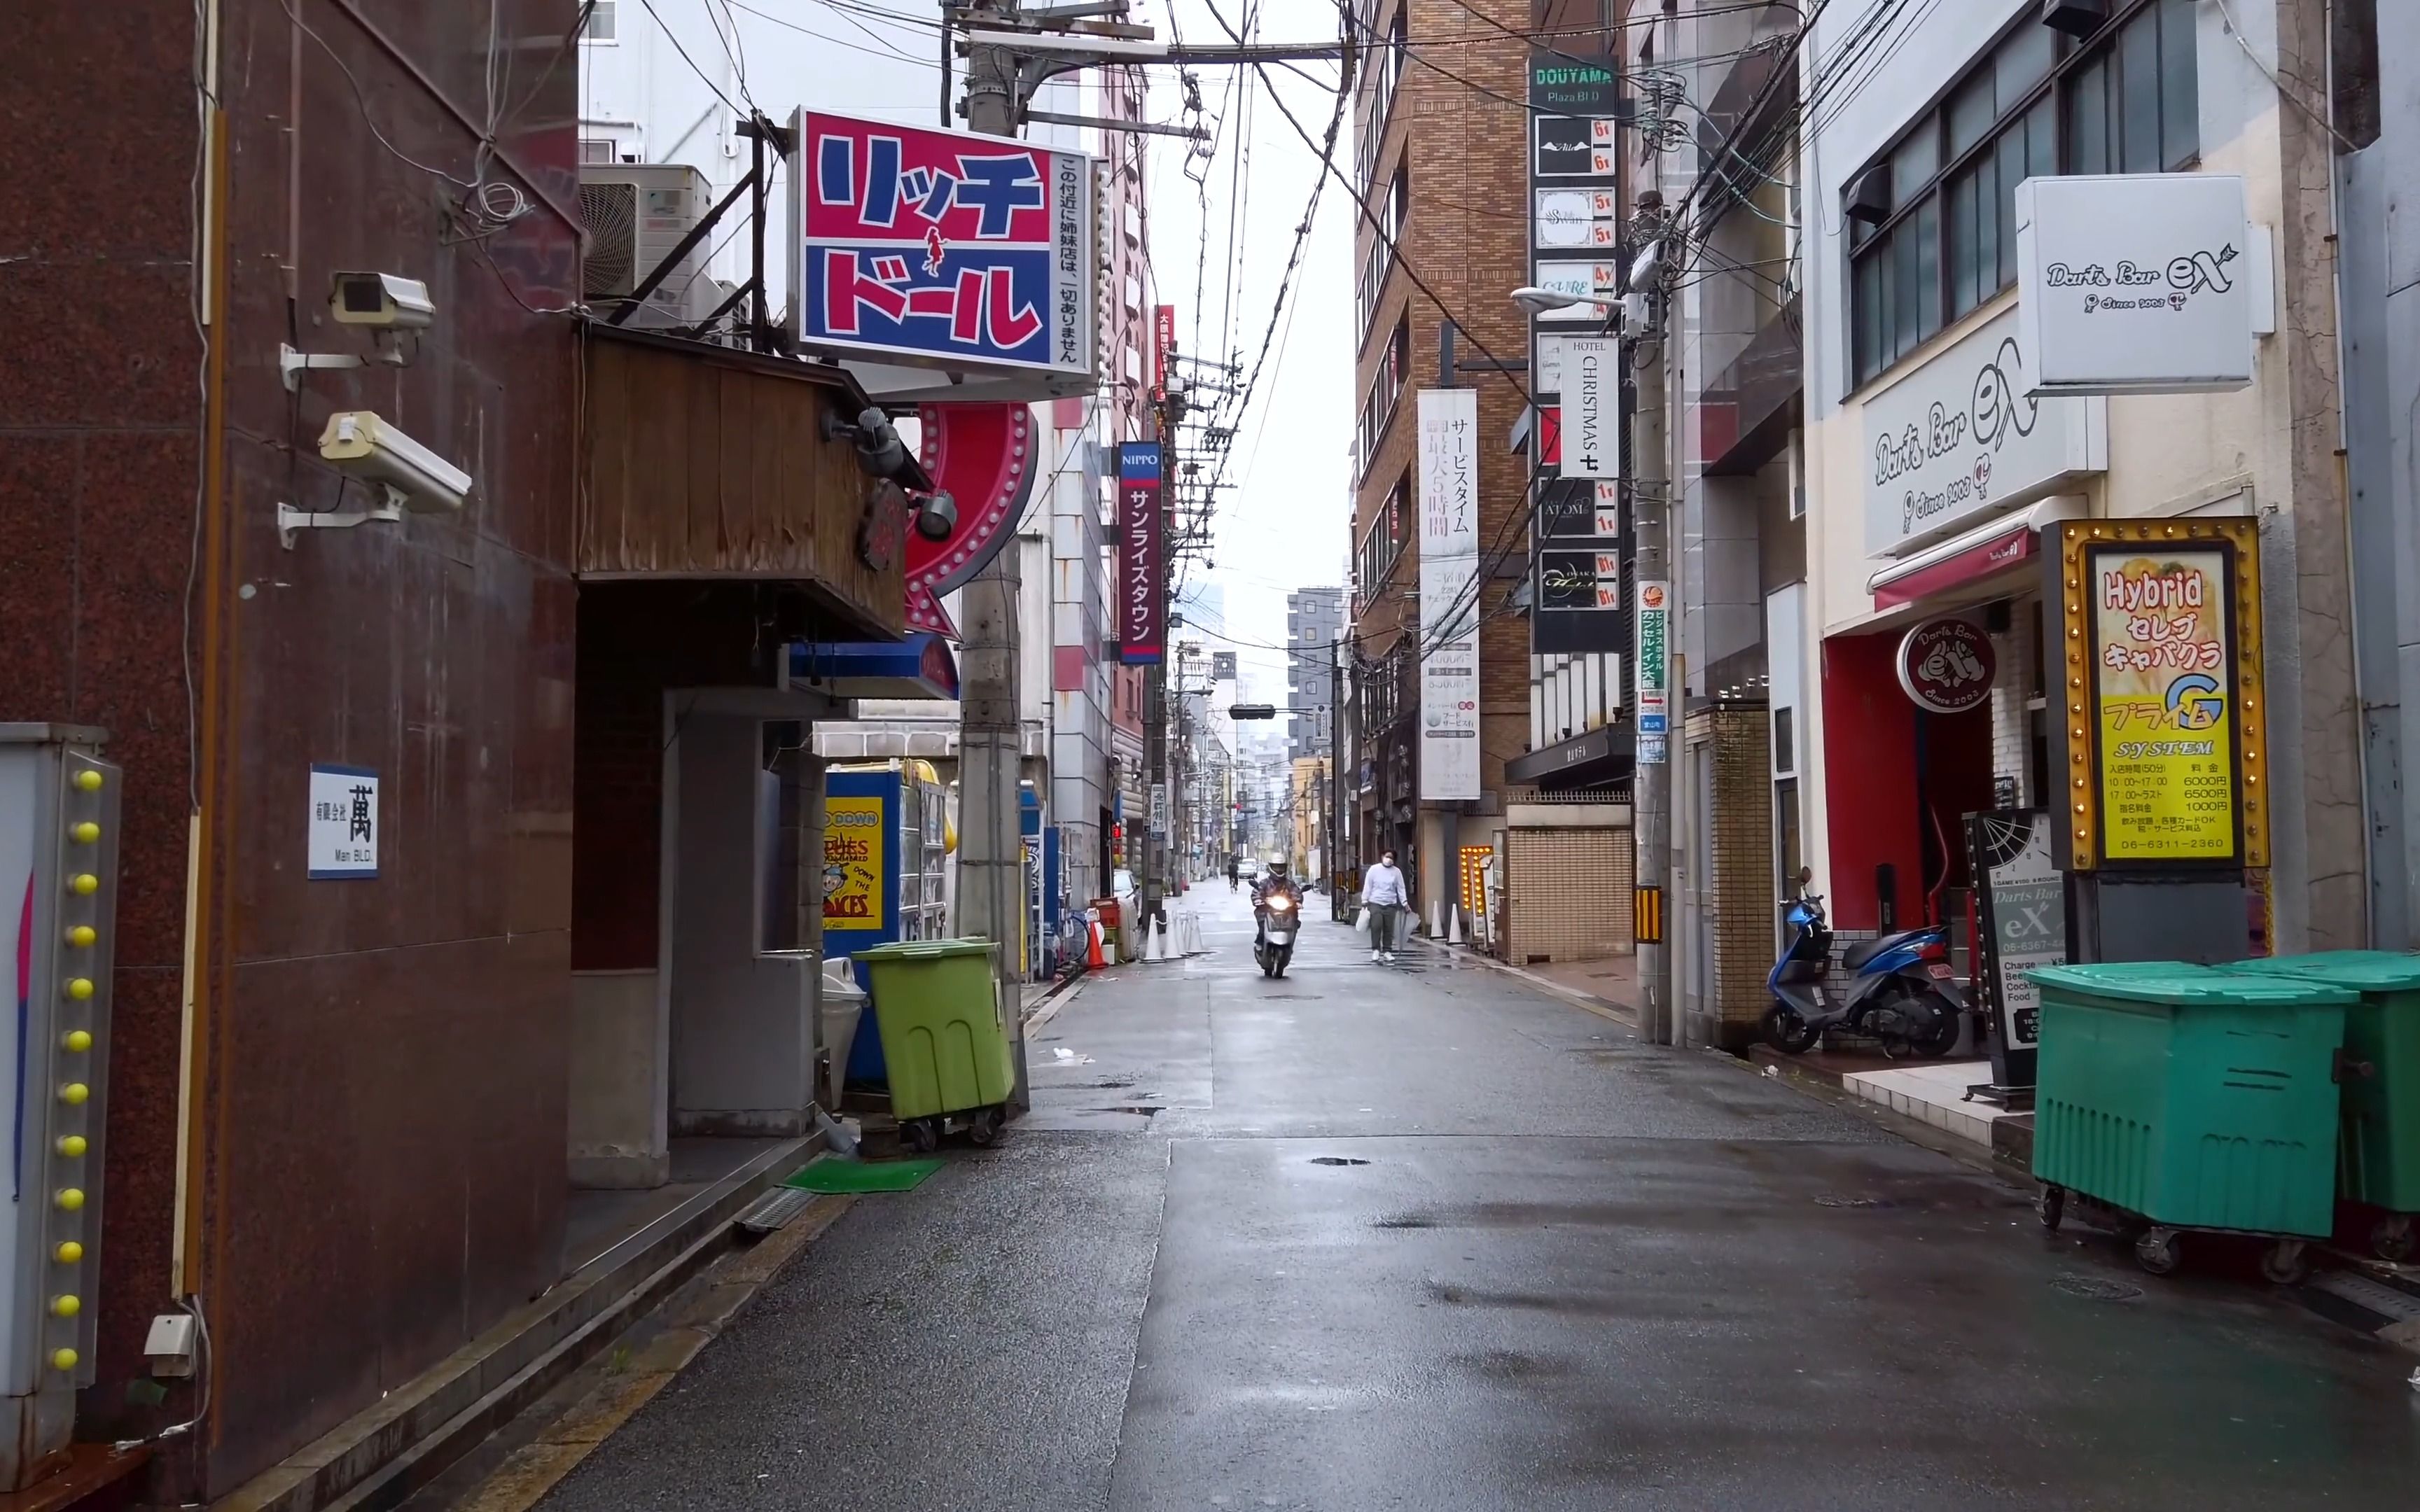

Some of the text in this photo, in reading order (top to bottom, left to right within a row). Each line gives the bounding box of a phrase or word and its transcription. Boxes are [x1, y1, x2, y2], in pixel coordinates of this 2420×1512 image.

[1536, 69, 1612, 85] DOUYAMA
[1548, 92, 1575, 102] Plaza
[817, 134, 1044, 239] リッチ
[1059, 158, 1077, 363] この付近に姉妹店は、一切ありません
[2116, 260, 2161, 285] Bar
[824, 248, 1043, 350] ドール
[2101, 297, 2136, 309] Since
[1573, 342, 1606, 351] HOTEL
[1583, 356, 1597, 450] CHRISTMAS
[1928, 401, 1967, 458] Bar
[1122, 455, 1157, 465] NIPPO
[1452, 419, 1468, 532] サービスタイム
[1916, 491, 1945, 519] Since
[1131, 491, 1149, 641] サンライズタウン
[2103, 570, 2203, 610] Hybrid
[1955, 624, 1977, 640] Bar
[2126, 612, 2198, 642] セレブ
[2103, 641, 2223, 672] キャバクラ
[1926, 689, 1950, 704] Since
[2103, 673, 2223, 731] プライム G
[2113, 740, 2213, 760] SYSTEM
[2183, 776, 2227, 786] 6000円
[2184, 789, 2227, 799] 6500円
[349, 784, 373, 843] 萬
[2186, 802, 2227, 811] 1000円
[2122, 839, 2223, 849] 06-6311-2360
[335, 849, 351, 862] Man
[853, 866, 875, 881] DOWN
[855, 880, 870, 892] THE
[1995, 888, 2063, 904] Darts Bar
[2005, 962, 2036, 970] Charge
[2008, 993, 2030, 1002] Food
